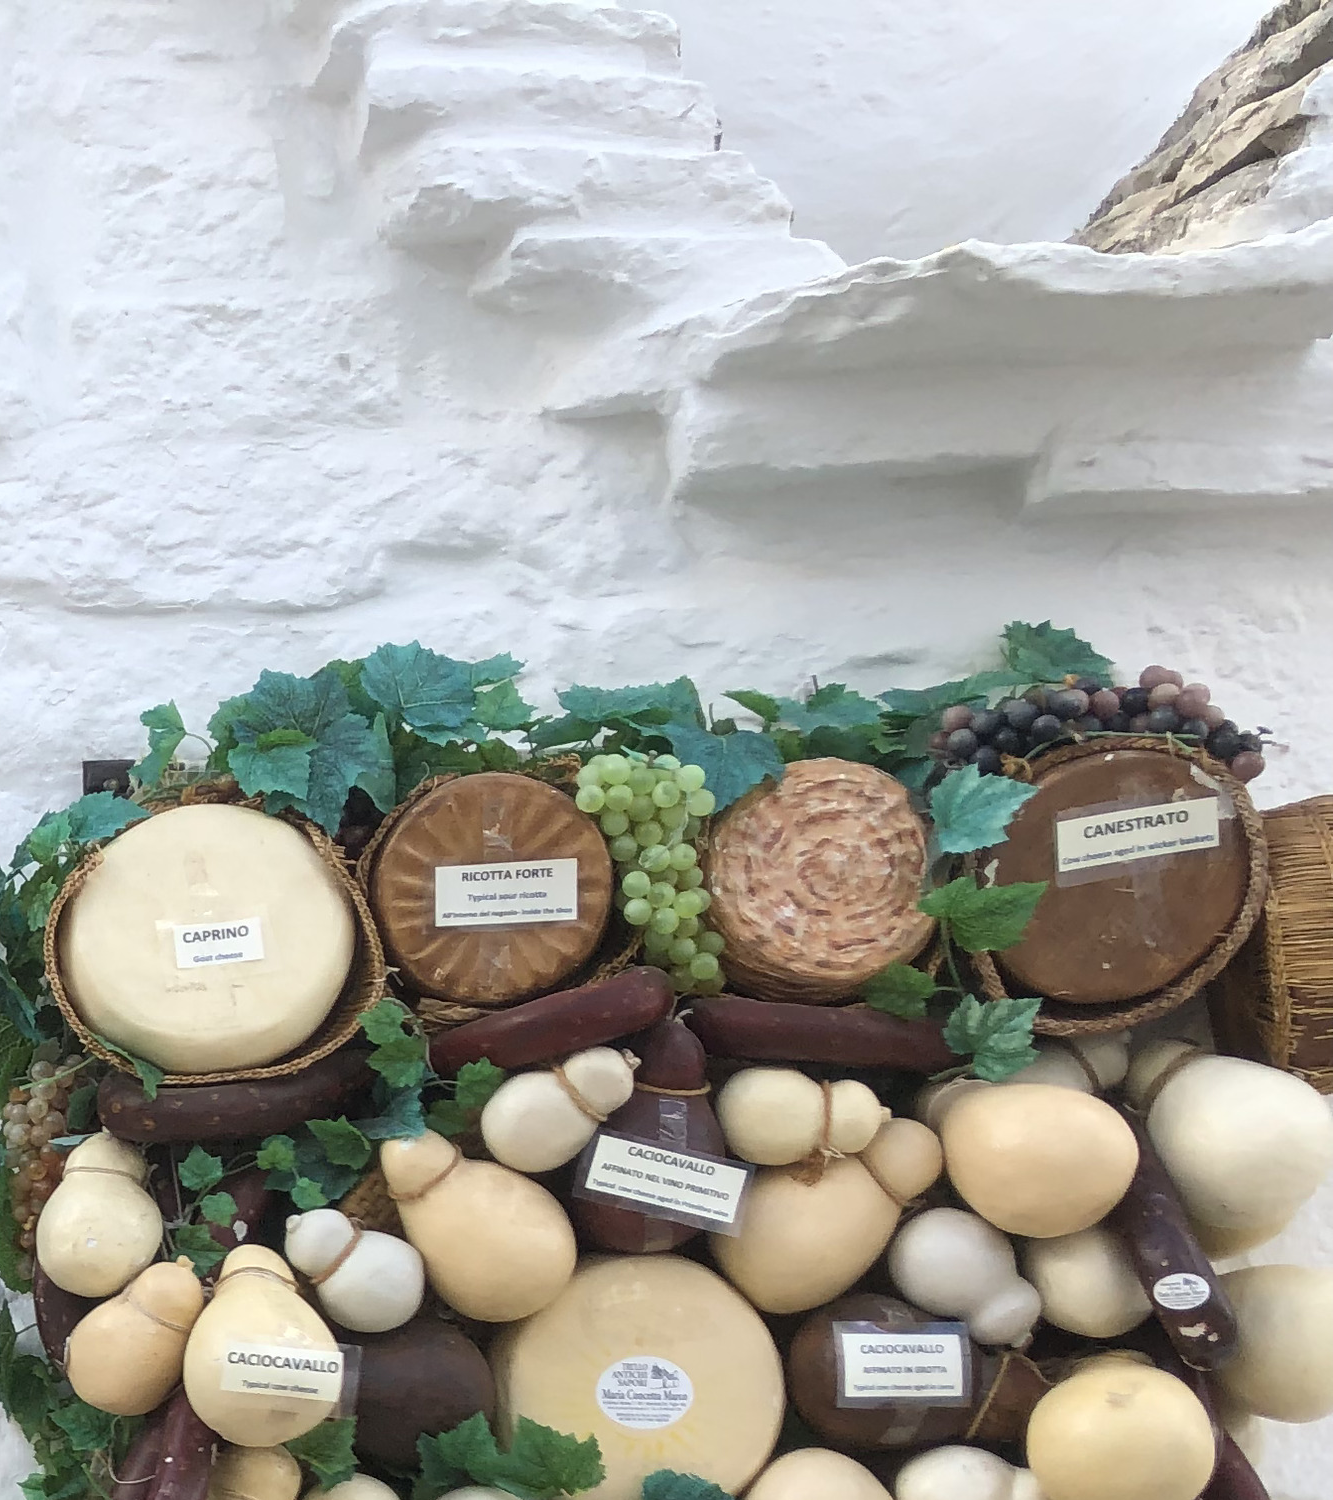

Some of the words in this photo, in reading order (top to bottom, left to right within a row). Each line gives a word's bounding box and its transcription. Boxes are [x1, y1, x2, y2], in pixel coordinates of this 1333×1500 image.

[1084, 810, 1188, 838] CANESTRATO
[462, 870, 512, 882] RICOTTA
[516, 868, 553, 879] FORTE
[183, 925, 249, 943] CAPRINO
[628, 1146, 715, 1176] CACIOCAVALLO
[601, 1163, 643, 1179] AFFINATO
[663, 1177, 683, 1189] VINO
[860, 1344, 945, 1354] CACIOCAVALLO
[228, 1352, 339, 1374] CACIOCAVALLO
[611, 1371, 648, 1379] ANTICHI
[618, 1379, 648, 1387] SAPORI
[602, 1389, 625, 1400] Maria
[626, 1389, 662, 1401] Concetta
[664, 1390, 687, 1401] Marco
